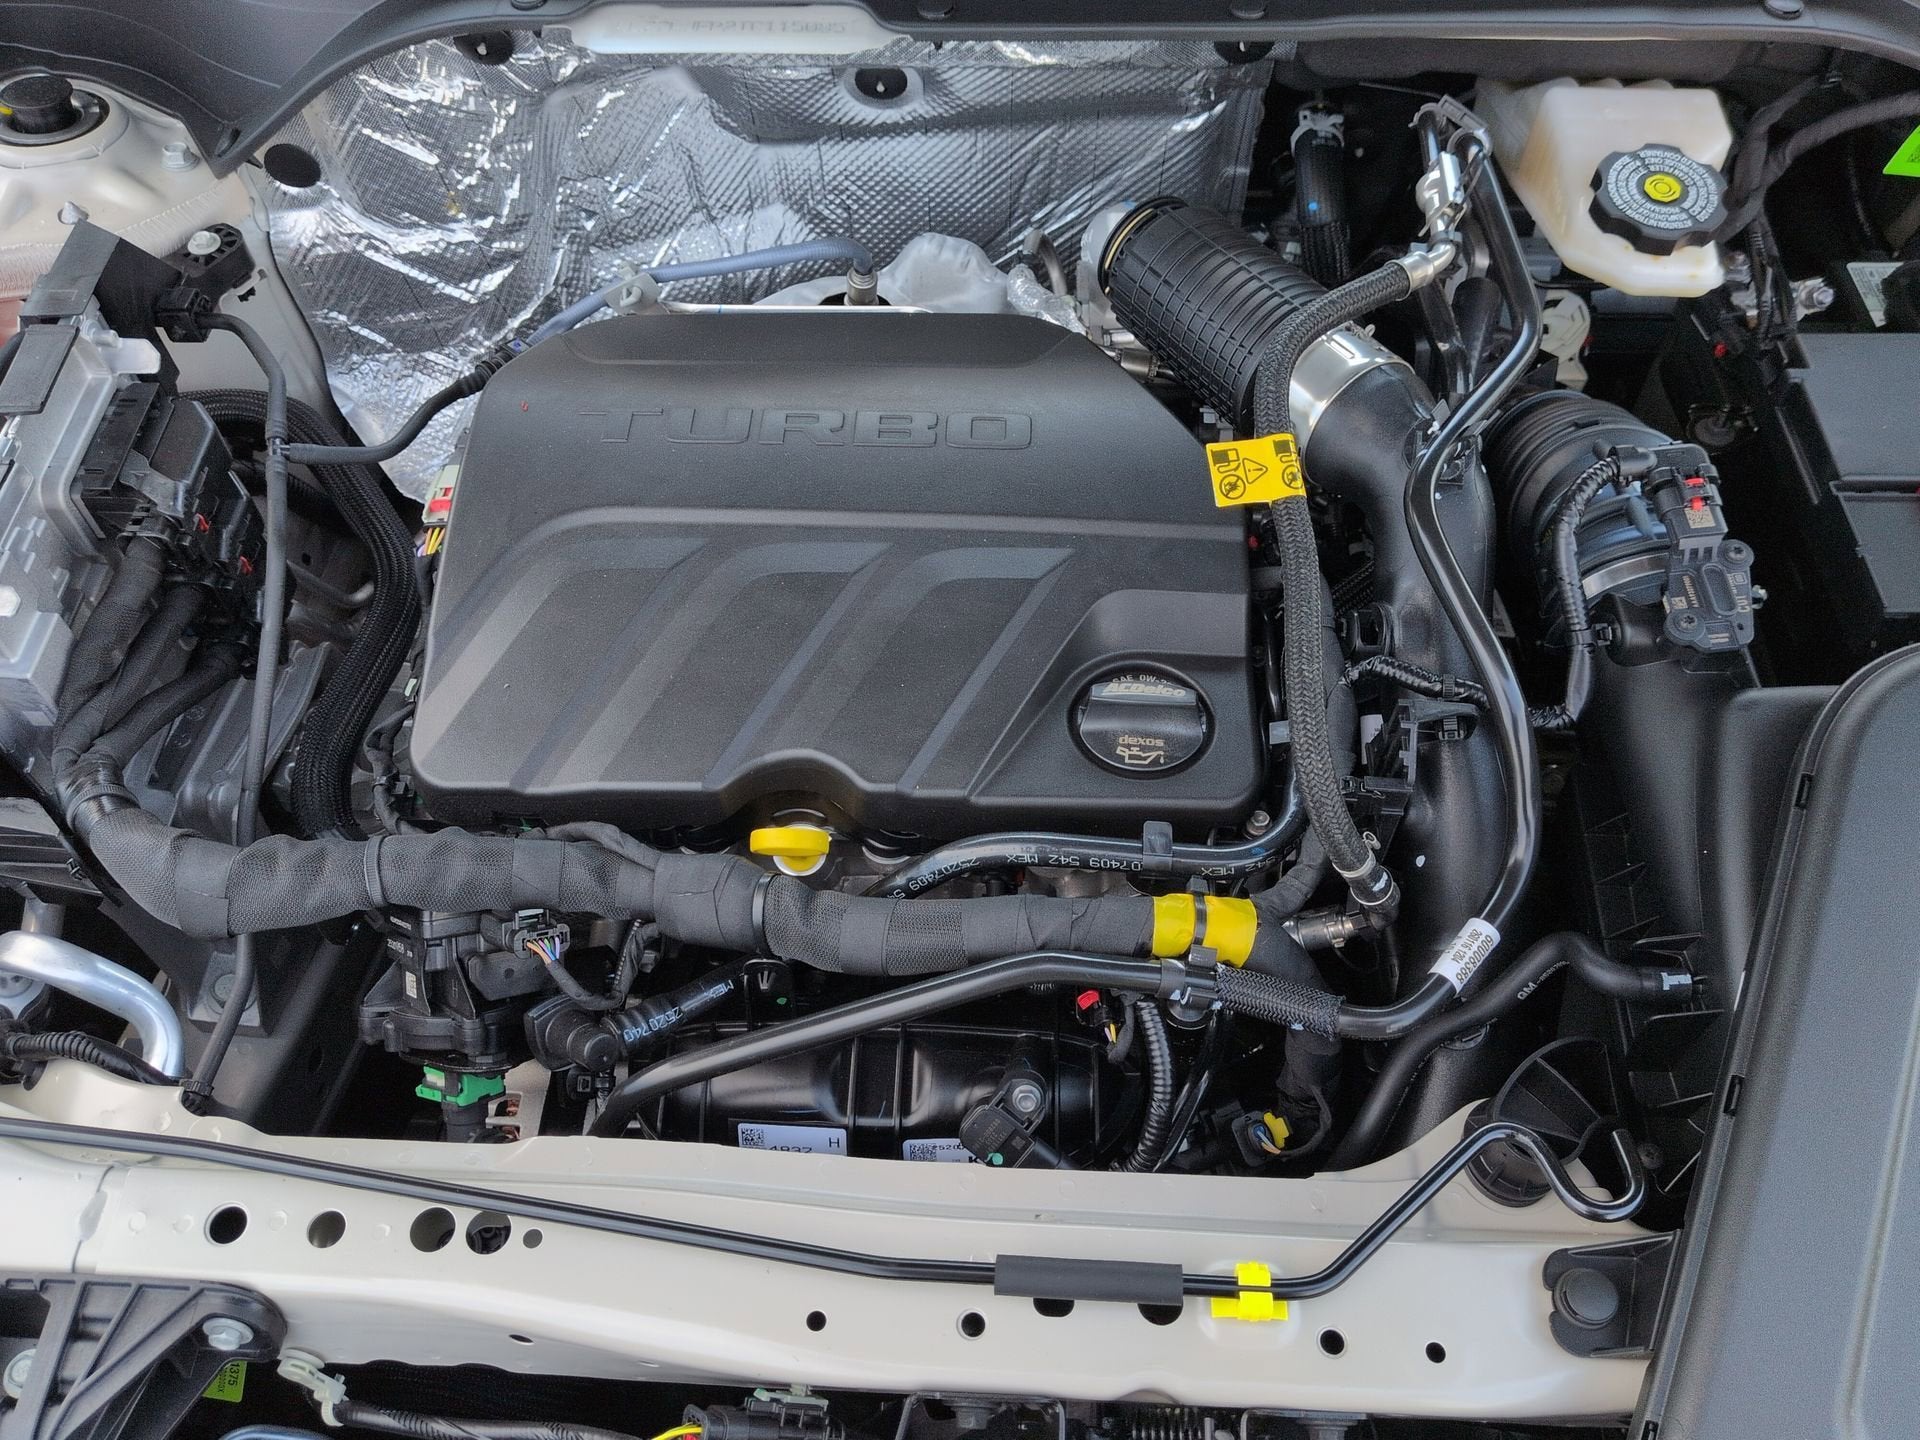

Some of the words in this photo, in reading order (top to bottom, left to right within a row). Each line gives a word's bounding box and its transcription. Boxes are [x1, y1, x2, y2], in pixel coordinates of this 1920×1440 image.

[578, 407, 1034, 450] TURBO
[1102, 683, 1186, 697] ACDelco
[1118, 734, 1165, 747] dexos
[1005, 853, 1039, 863] MEX
[1201, 866, 1235, 876] MEX
[1455, 934, 1494, 984] 60008388
[828, 1136, 841, 1149] H
[228, 1362, 241, 1387] 1375
